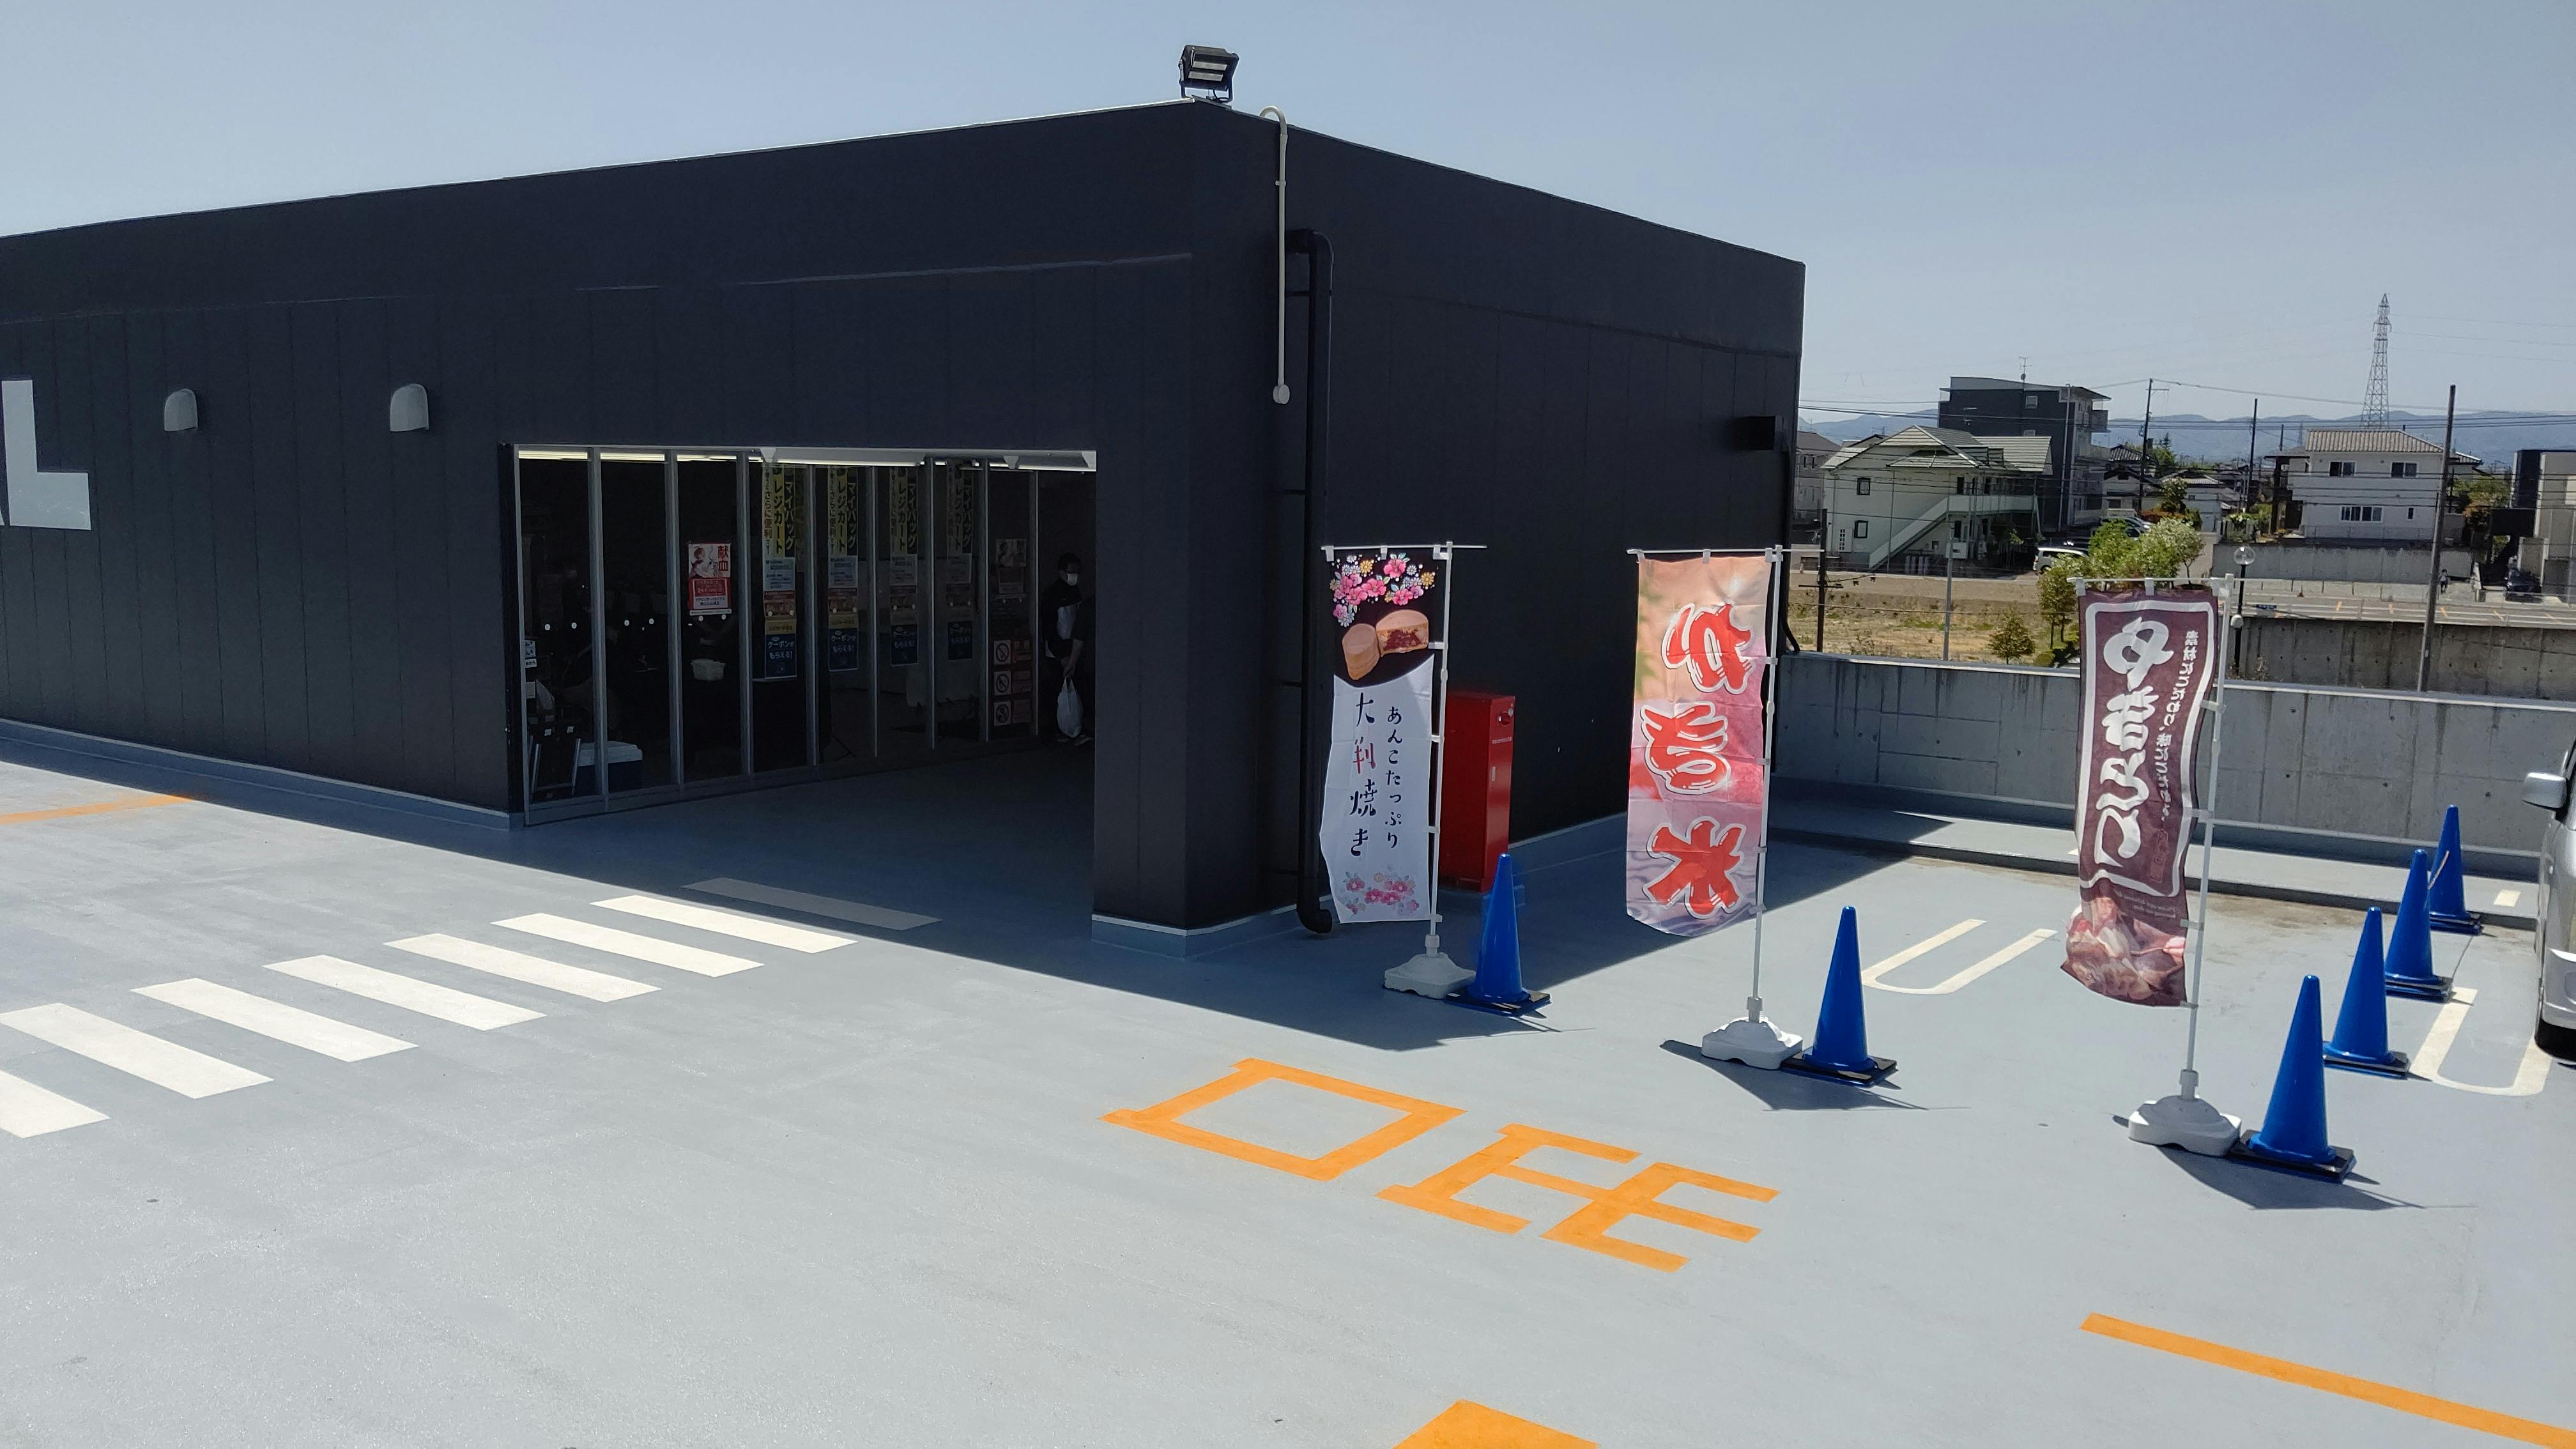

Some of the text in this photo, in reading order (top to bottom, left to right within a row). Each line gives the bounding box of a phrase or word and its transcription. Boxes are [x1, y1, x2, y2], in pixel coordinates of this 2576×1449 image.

[1349, 691, 1377, 857] 大判焼き
[1384, 705, 1404, 850] あんこたっぷり
